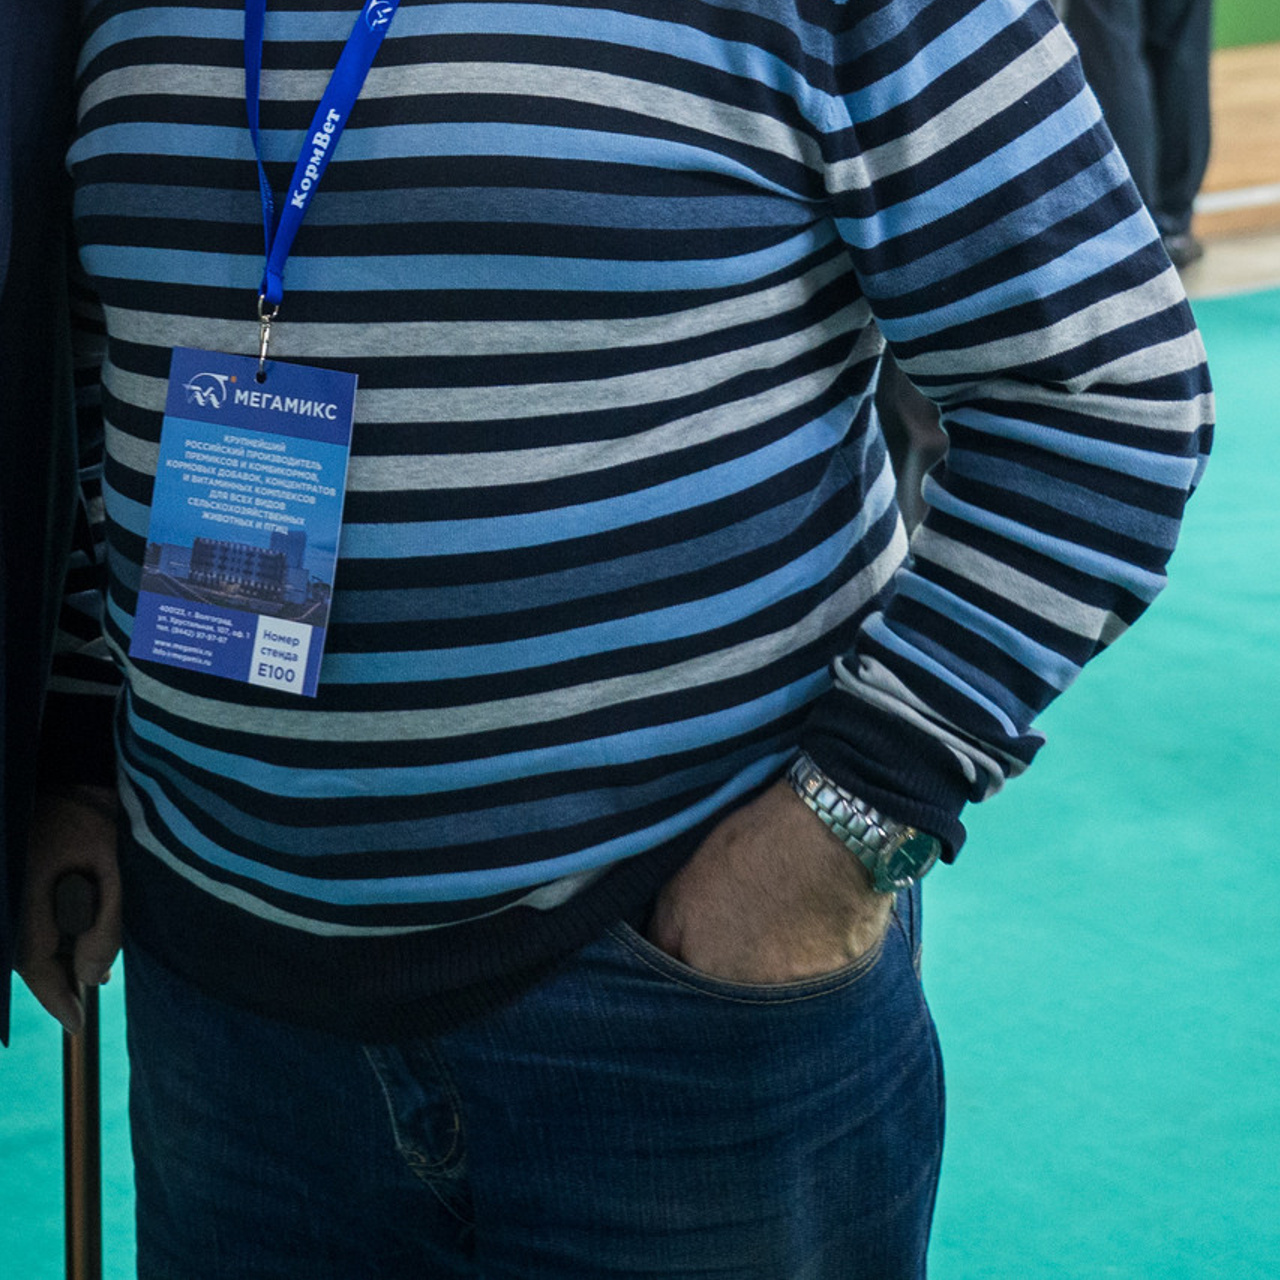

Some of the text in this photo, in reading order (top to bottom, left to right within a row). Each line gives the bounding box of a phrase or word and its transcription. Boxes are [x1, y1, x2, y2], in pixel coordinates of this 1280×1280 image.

[291, 108, 341, 210] КормВет
[233, 388, 339, 421] МЕГАМИКС
[184, 439, 323, 470] РОССИЙСКИЙ ПРОИЗВОДИТЕЛЬ
[223, 435, 286, 452] КРУПНЕЙШИЙ
[184, 451, 238, 468] ПРЕМИКСОВ
[240, 460, 247, 469] И
[166, 459, 337, 497] КОРМОВЫХ ДОБАВОК, КОНЦЕНТРАТОВ
[182, 473, 316, 505] И ВИТАМИННЫХ КОМПЛЕКСОВ
[187, 497, 305, 525] СЕЛЬСКОХОЗЯЙСТВЕННЫХ
[209, 490, 286, 511] ДЛЯ ВСЕХ ВИДОВ
[201, 511, 289, 535] ЖИВОТНЫХ И ПТИЦ
[263, 629, 301, 648] Номер
[260, 646, 299, 662] стенда
[257, 662, 297, 683] E100
